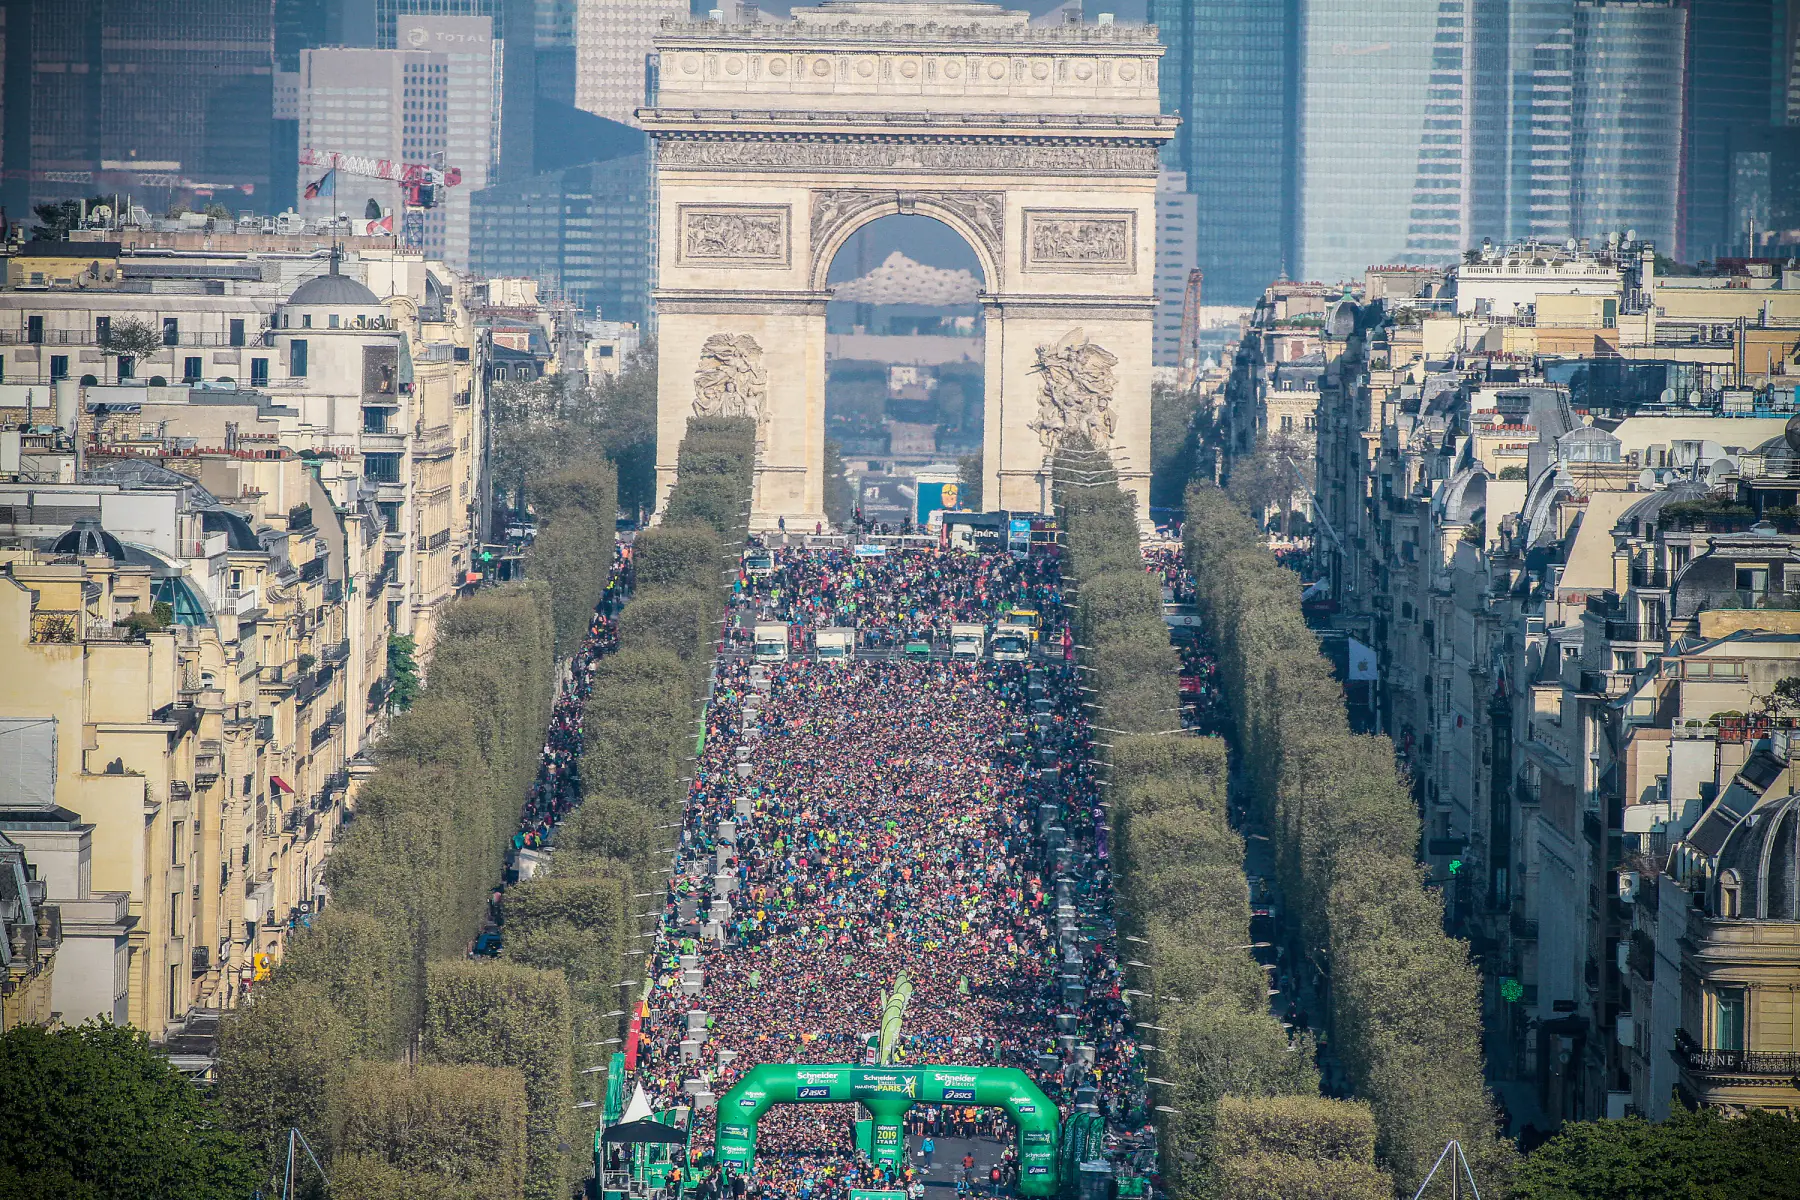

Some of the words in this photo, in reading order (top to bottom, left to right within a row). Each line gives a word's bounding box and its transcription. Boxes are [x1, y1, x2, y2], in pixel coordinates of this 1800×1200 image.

[436, 32, 486, 42] TOTAL
[344, 317, 380, 330] LOUIS
[797, 1071, 838, 1079] Schneider
[934, 1074, 976, 1082] Schneider
[877, 1130, 897, 1139] 2019
